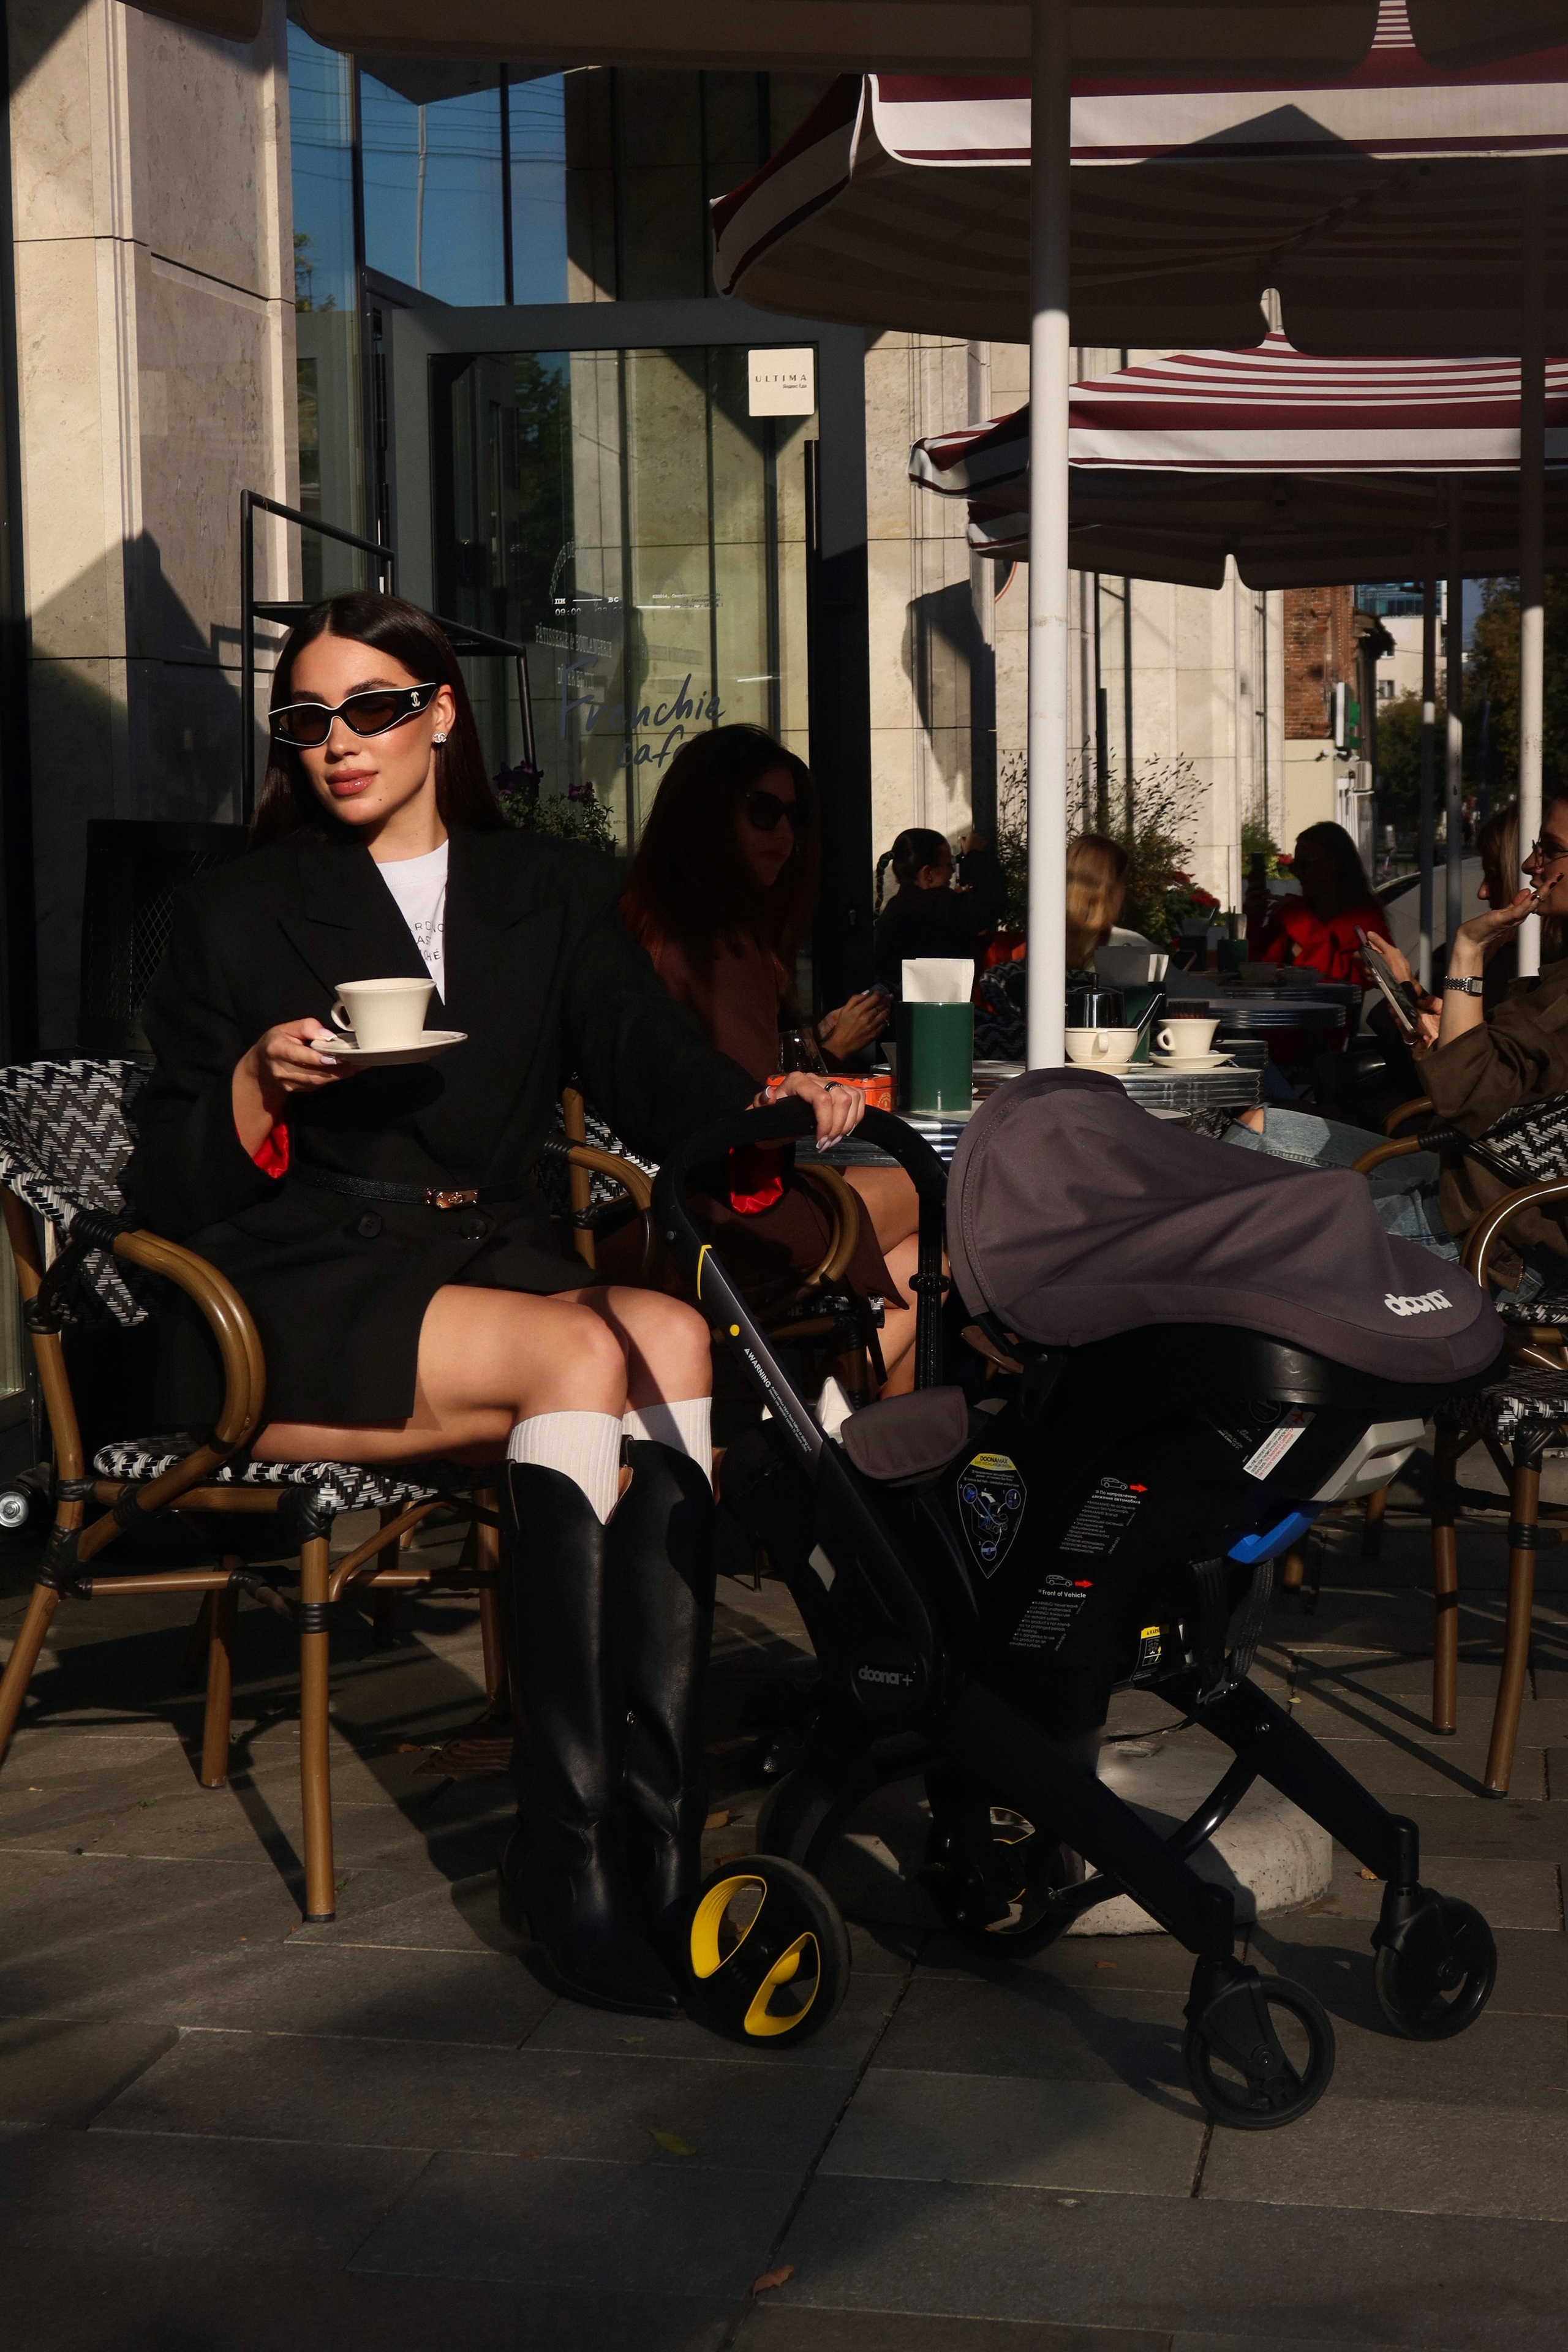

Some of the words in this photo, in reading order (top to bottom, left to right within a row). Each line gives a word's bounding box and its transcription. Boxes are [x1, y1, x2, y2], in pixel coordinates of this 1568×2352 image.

[555, 608, 581, 616] 09:00
[535, 621, 569, 649] PÂTISSERIE
[559, 656, 726, 739] Frenchie
[747, 1352, 772, 1388] WARNING
